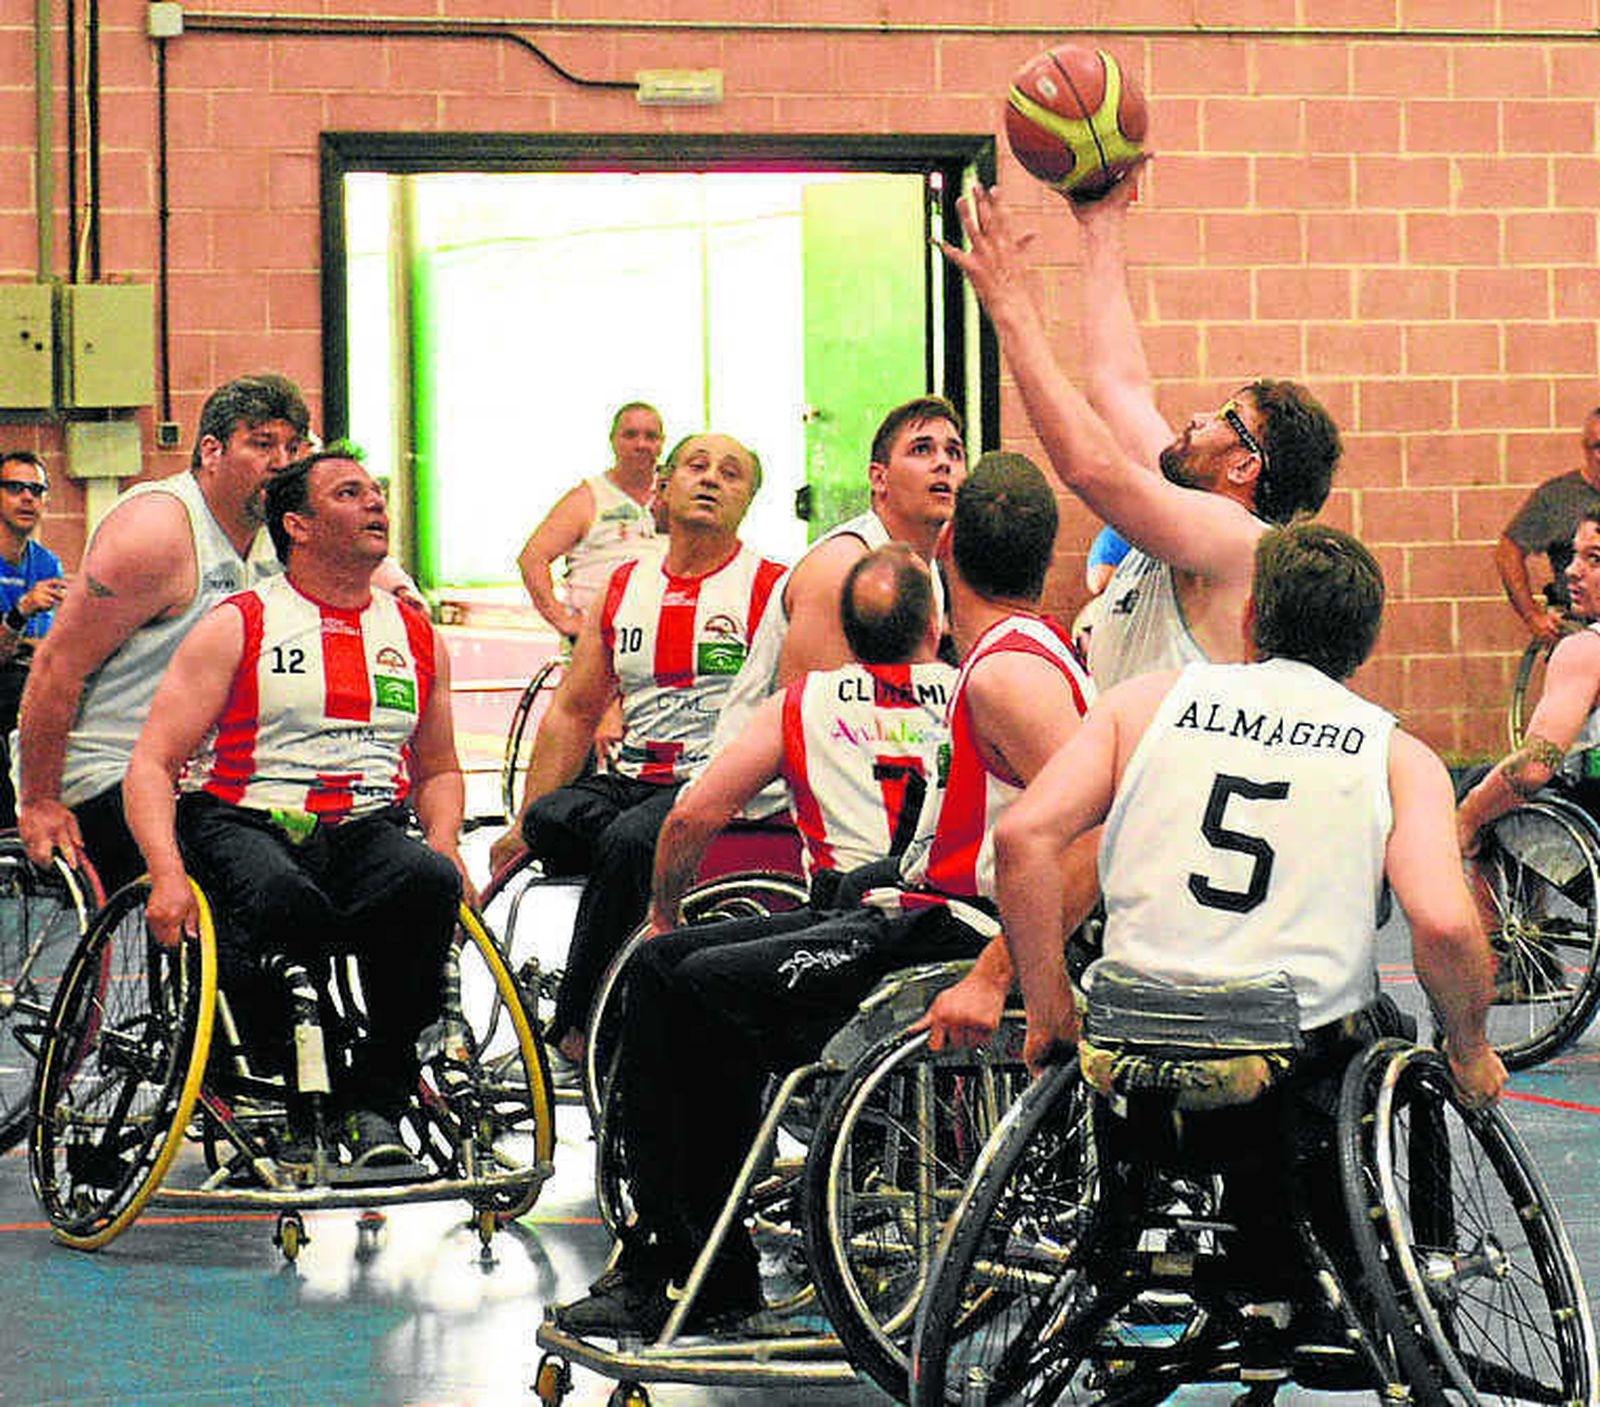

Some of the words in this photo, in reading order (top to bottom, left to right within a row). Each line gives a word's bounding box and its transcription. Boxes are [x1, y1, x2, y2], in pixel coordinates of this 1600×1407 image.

[271, 646, 306, 674] 12
[620, 627, 643, 654] 10
[838, 677, 947, 706] CLMI
[1174, 700, 1365, 755] ALMAGRO
[872, 763, 928, 857] 7
[1188, 773, 1291, 914] 5
